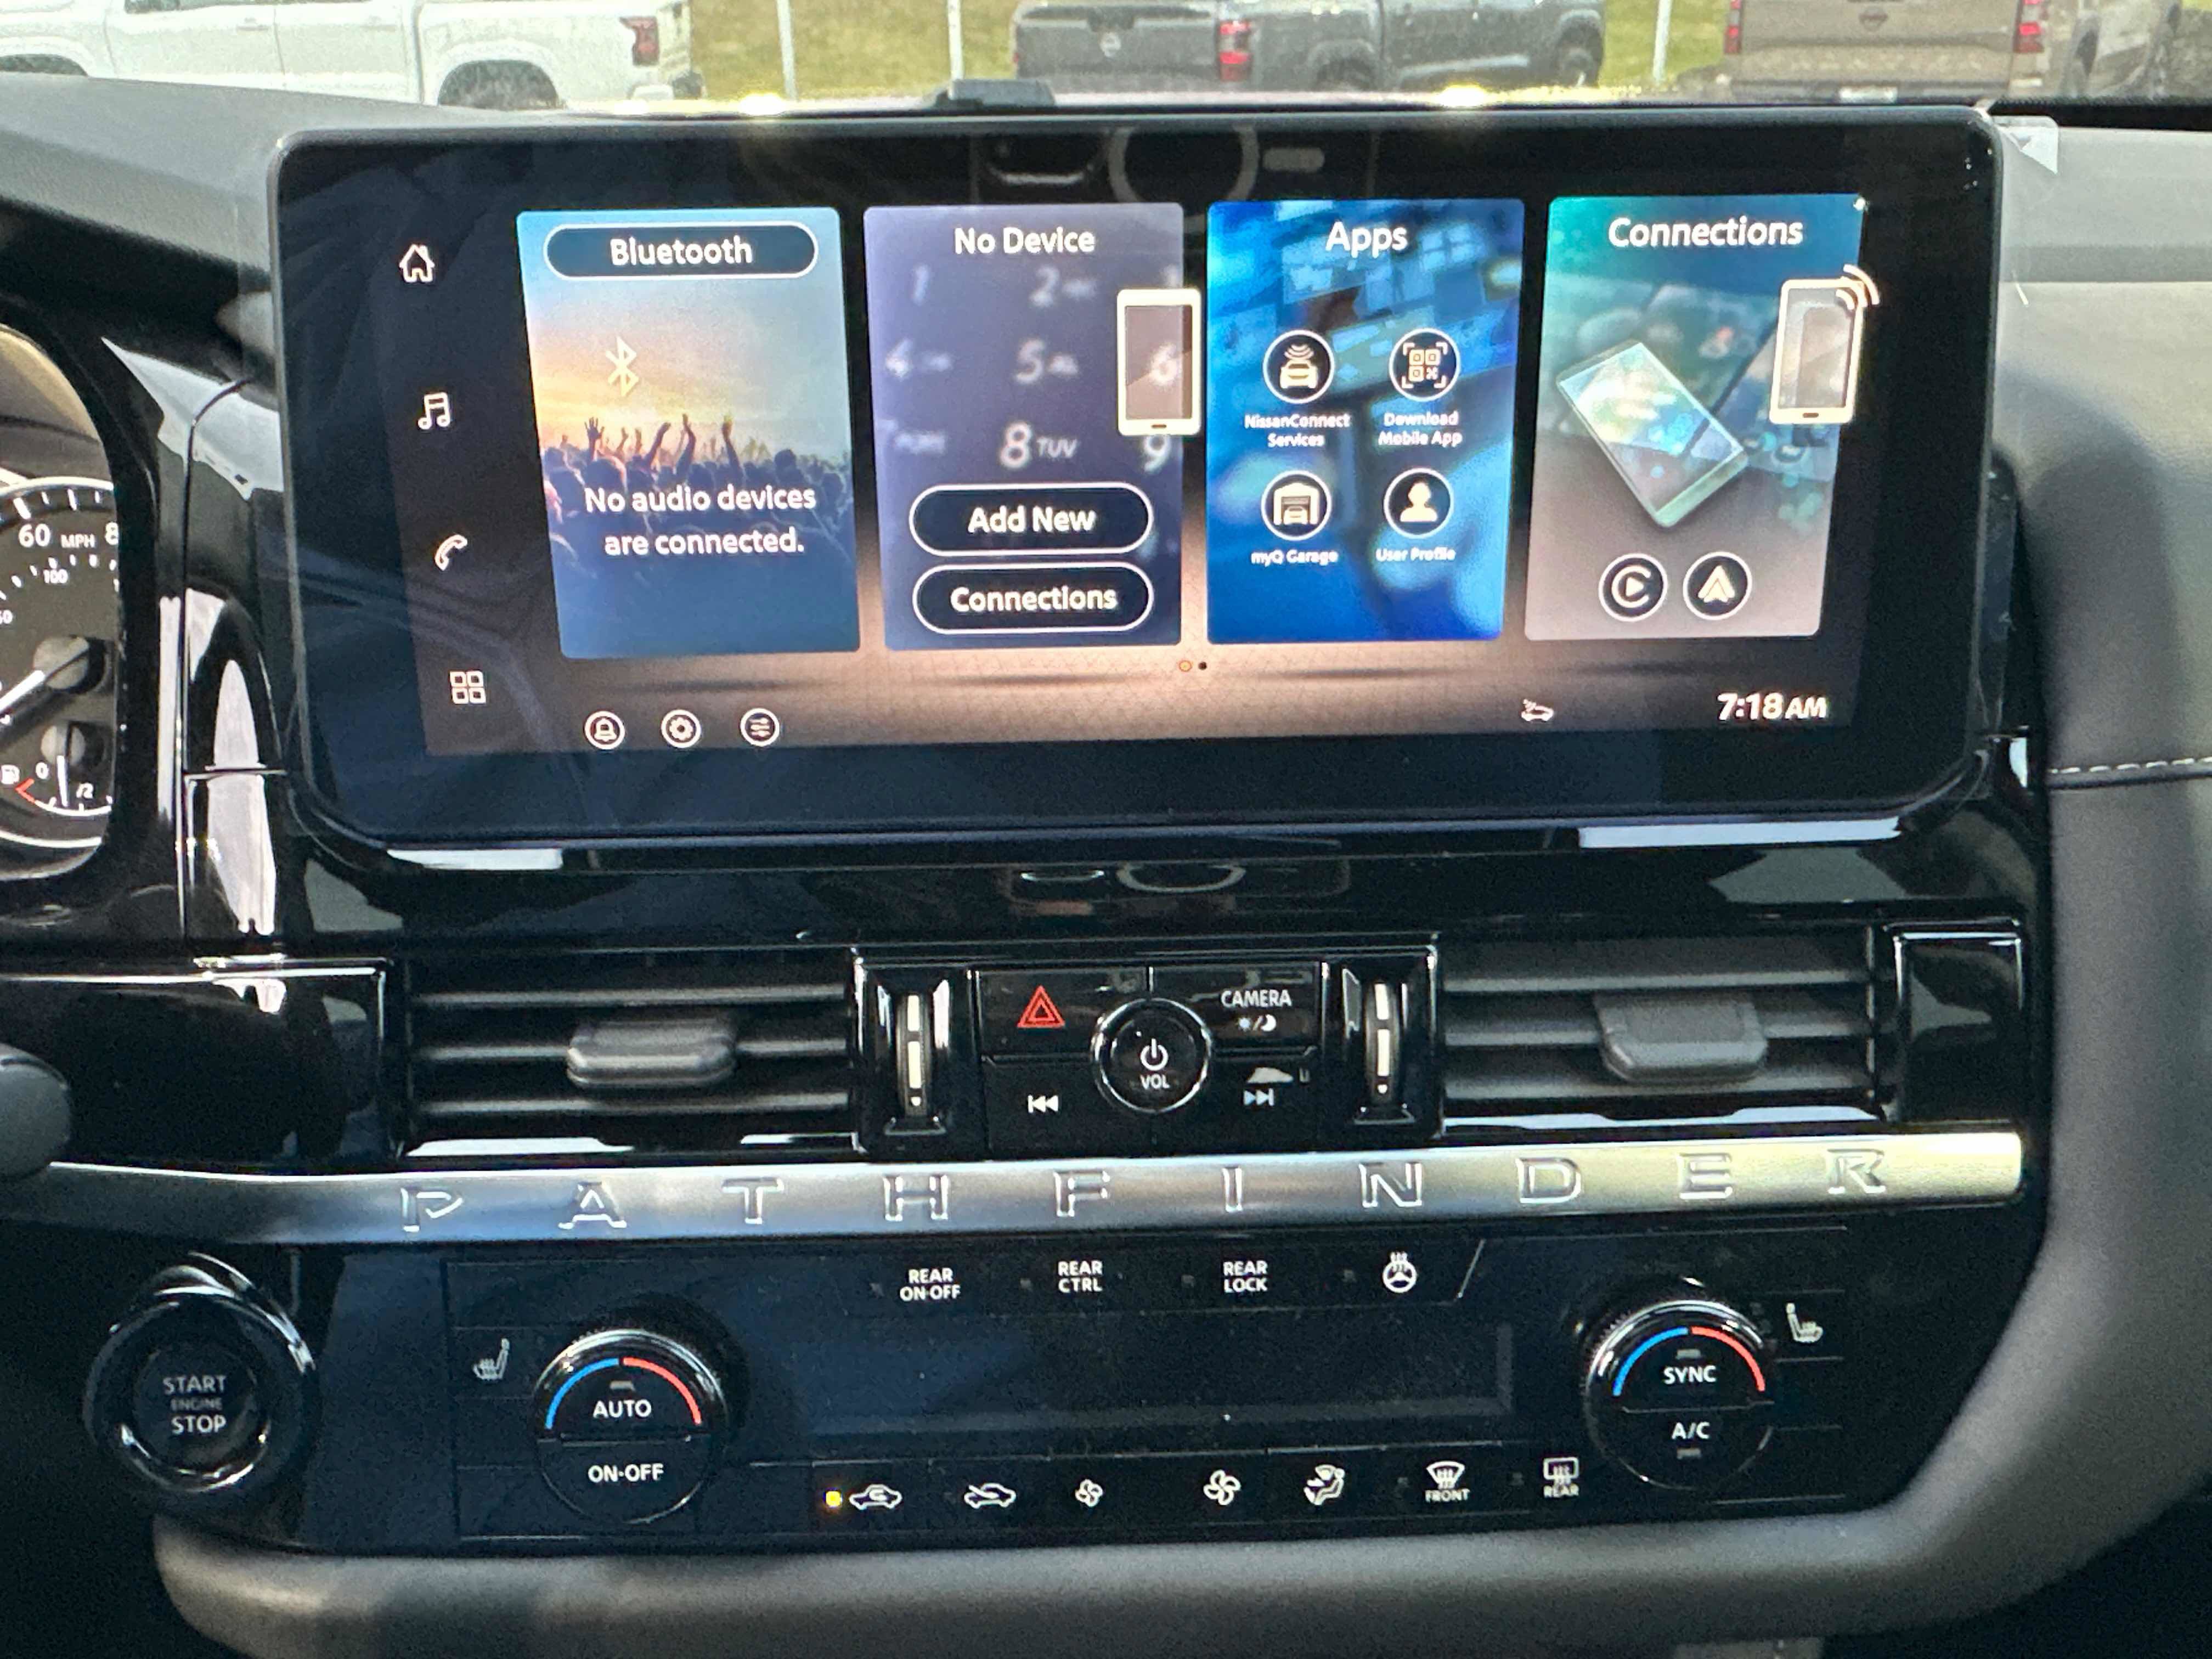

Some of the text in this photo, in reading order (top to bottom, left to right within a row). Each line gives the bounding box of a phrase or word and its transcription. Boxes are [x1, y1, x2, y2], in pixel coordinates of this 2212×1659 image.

[954, 226, 1095, 254] No Device
[1325, 221, 1408, 257] Apps
[1607, 216, 1804, 248] Connections
[610, 236, 753, 266] Bluetooth
[1244, 413, 1351, 428] NissanConnect
[1384, 410, 1459, 427] Download
[1000, 421, 1077, 470] 8 TUV
[1267, 432, 1325, 448] Services
[1378, 430, 1463, 448] Mobile App
[585, 484, 817, 513] No audio devices
[967, 505, 1097, 533] Add New
[18, 523, 51, 548] 60
[60, 533, 95, 548] MPH
[604, 526, 805, 556] are connected.
[1251, 549, 1339, 567] myQ Garage
[1375, 546, 1456, 562] User Profile
[43, 568, 69, 584] 100
[950, 585, 1118, 612] Connections
[1221, 989, 1292, 1008] CAMERA
[1141, 1073, 1170, 1090] VOL
[908, 1267, 953, 1284] REAR
[1057, 1260, 1103, 1277] REAR
[1222, 1260, 1268, 1277] REAR
[1058, 1277, 1103, 1293] CTRL
[1223, 1277, 1268, 1293] LOCK
[1663, 1365, 1717, 1385] SYNC
[163, 1374, 226, 1395] START
[171, 1397, 222, 1412] ENGINE
[593, 1399, 652, 1419] AUTO
[171, 1414, 226, 1435] STOP
[1671, 1422, 1710, 1440] A/C
[1425, 1488, 1470, 1502] FRONT
[1543, 1482, 1579, 1498] REAR
